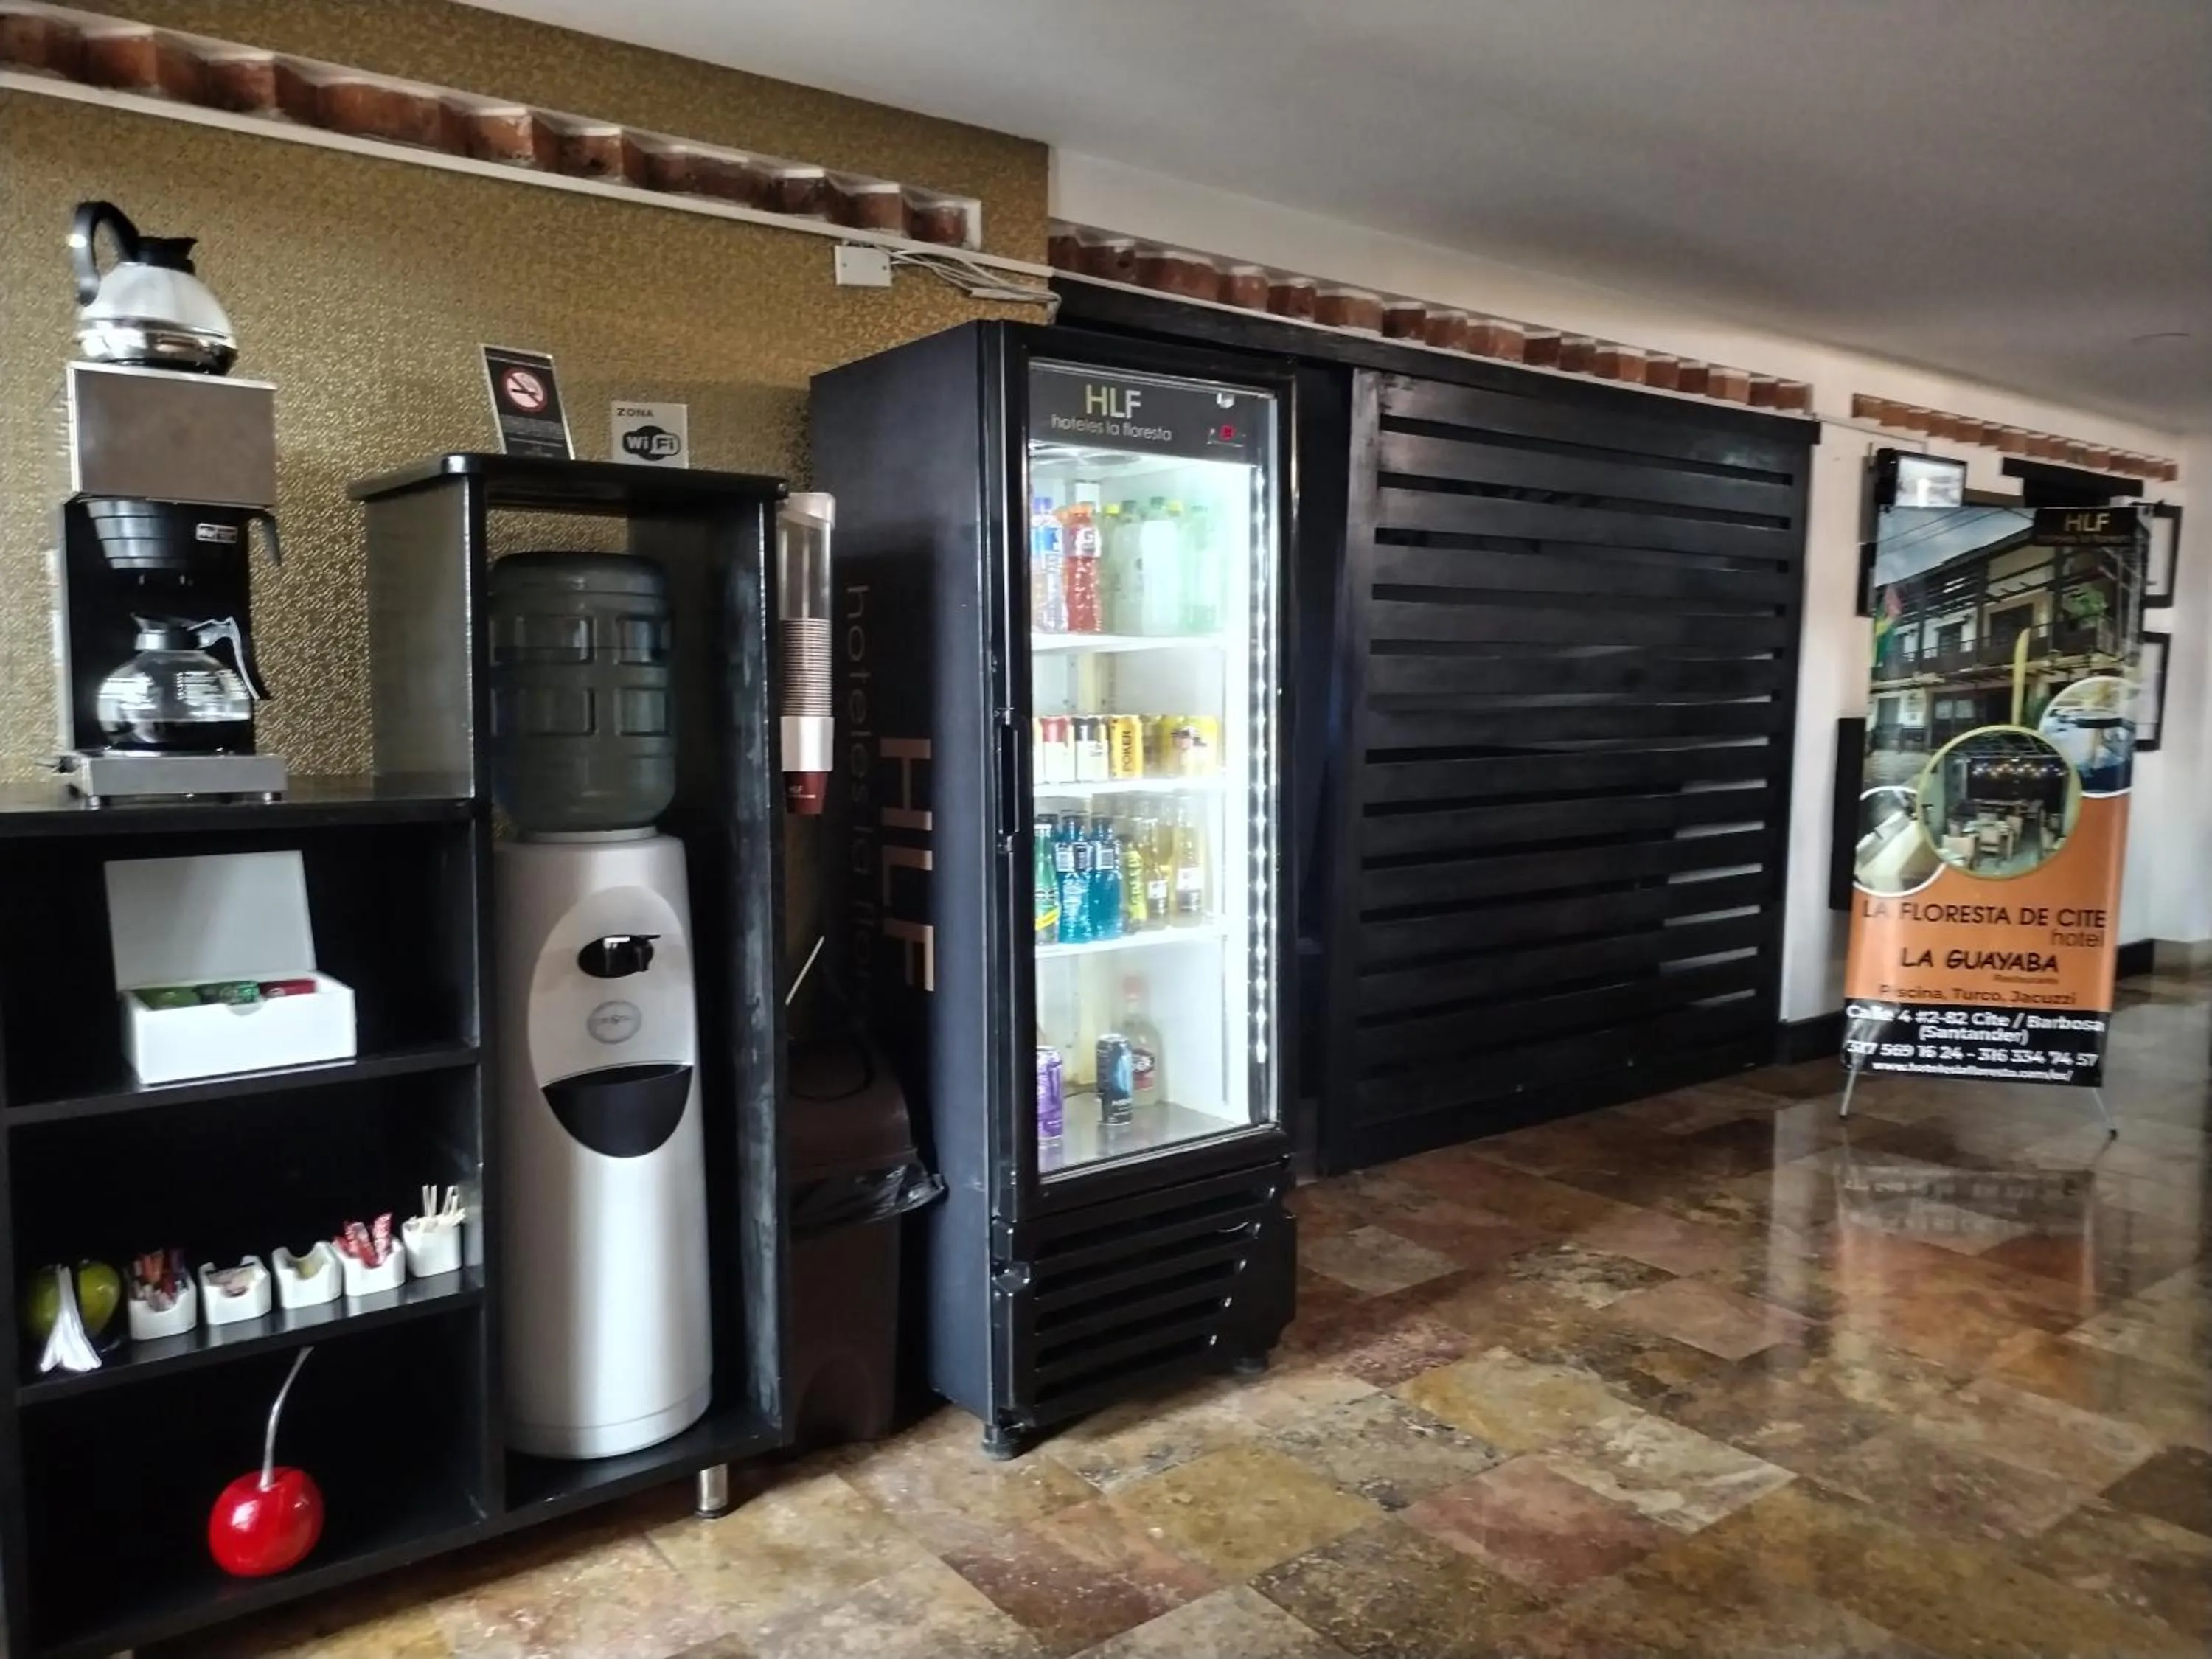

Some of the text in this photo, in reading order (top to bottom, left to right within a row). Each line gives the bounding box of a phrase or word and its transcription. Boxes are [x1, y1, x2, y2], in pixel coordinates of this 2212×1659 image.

[616, 407, 654, 417] ZONA
[1085, 384, 1141, 419] HLF
[1051, 414, 1173, 442] hoteles la floresta
[2064, 512, 2111, 532] HLF
[846, 585, 872, 803] hoteles
[1121, 731, 1133, 771] POKER
[880, 737, 935, 992] HLF
[1863, 900, 2106, 928] LA FLORESTA DE CITE
[2051, 928, 2104, 947] hotel
[1902, 947, 2059, 973] LA GUAYABA
[1880, 984, 2077, 1005] Pscina, Turco, Jacuzzi
[1897, 1009, 1913, 1023] 4
[1971, 1011, 2011, 1027] Cite
[2011, 1012, 2025, 1029] /
[2026, 1015, 2105, 1032] Barbosa
[1919, 1024, 2029, 1046] (Santander)
[1938, 1046, 1965, 1060] 24
[2048, 1051, 2074, 1065] 74
[2075, 1052, 2100, 1066] 57
